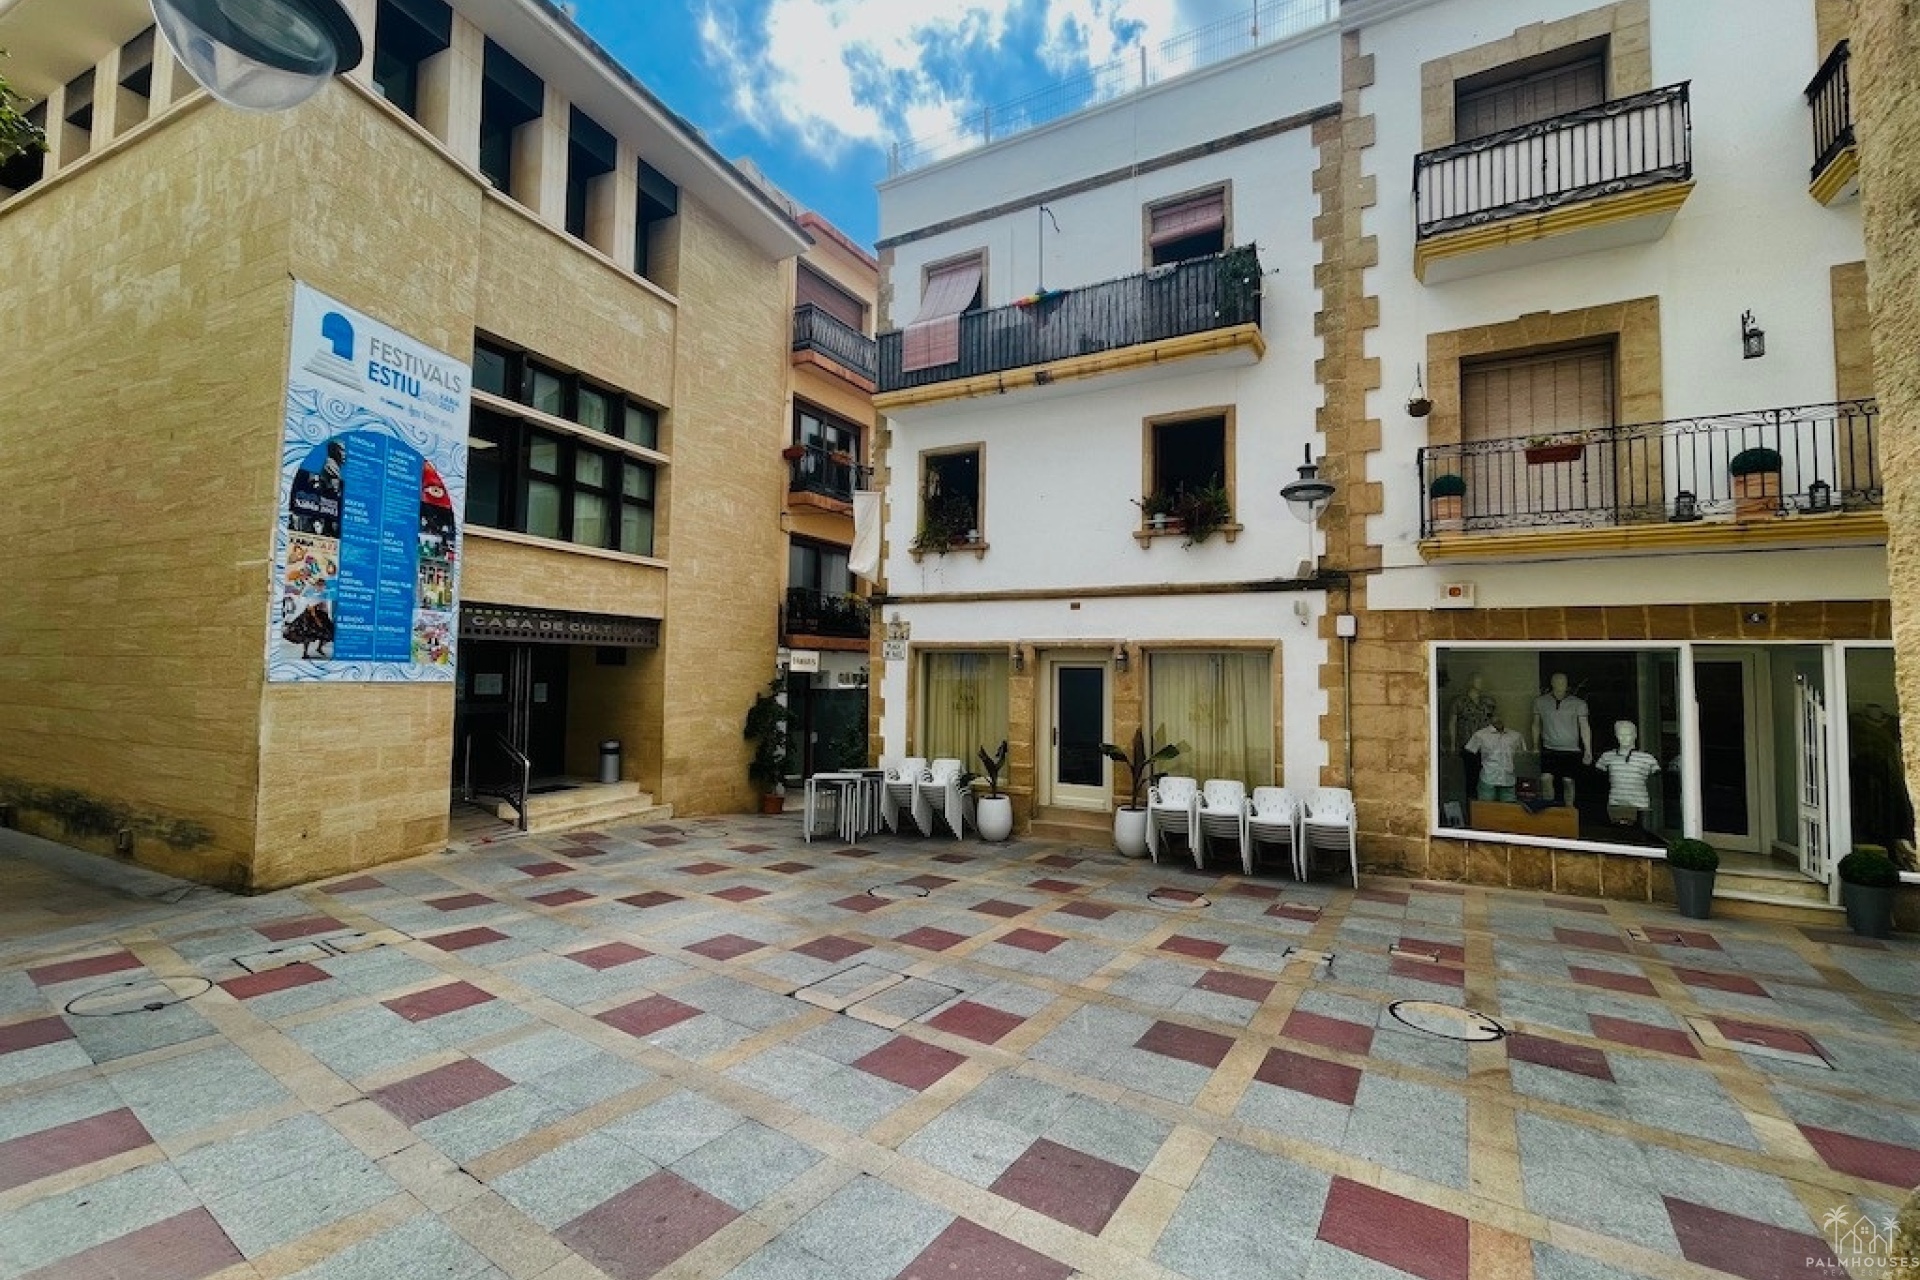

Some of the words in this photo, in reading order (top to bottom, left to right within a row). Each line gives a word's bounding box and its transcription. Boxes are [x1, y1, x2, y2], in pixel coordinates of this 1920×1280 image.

[368, 360, 421, 399] ESTIU
[370, 337, 462, 394] FESTIVALS
[472, 615, 534, 630] CASA
[540, 621, 564, 632] DE
